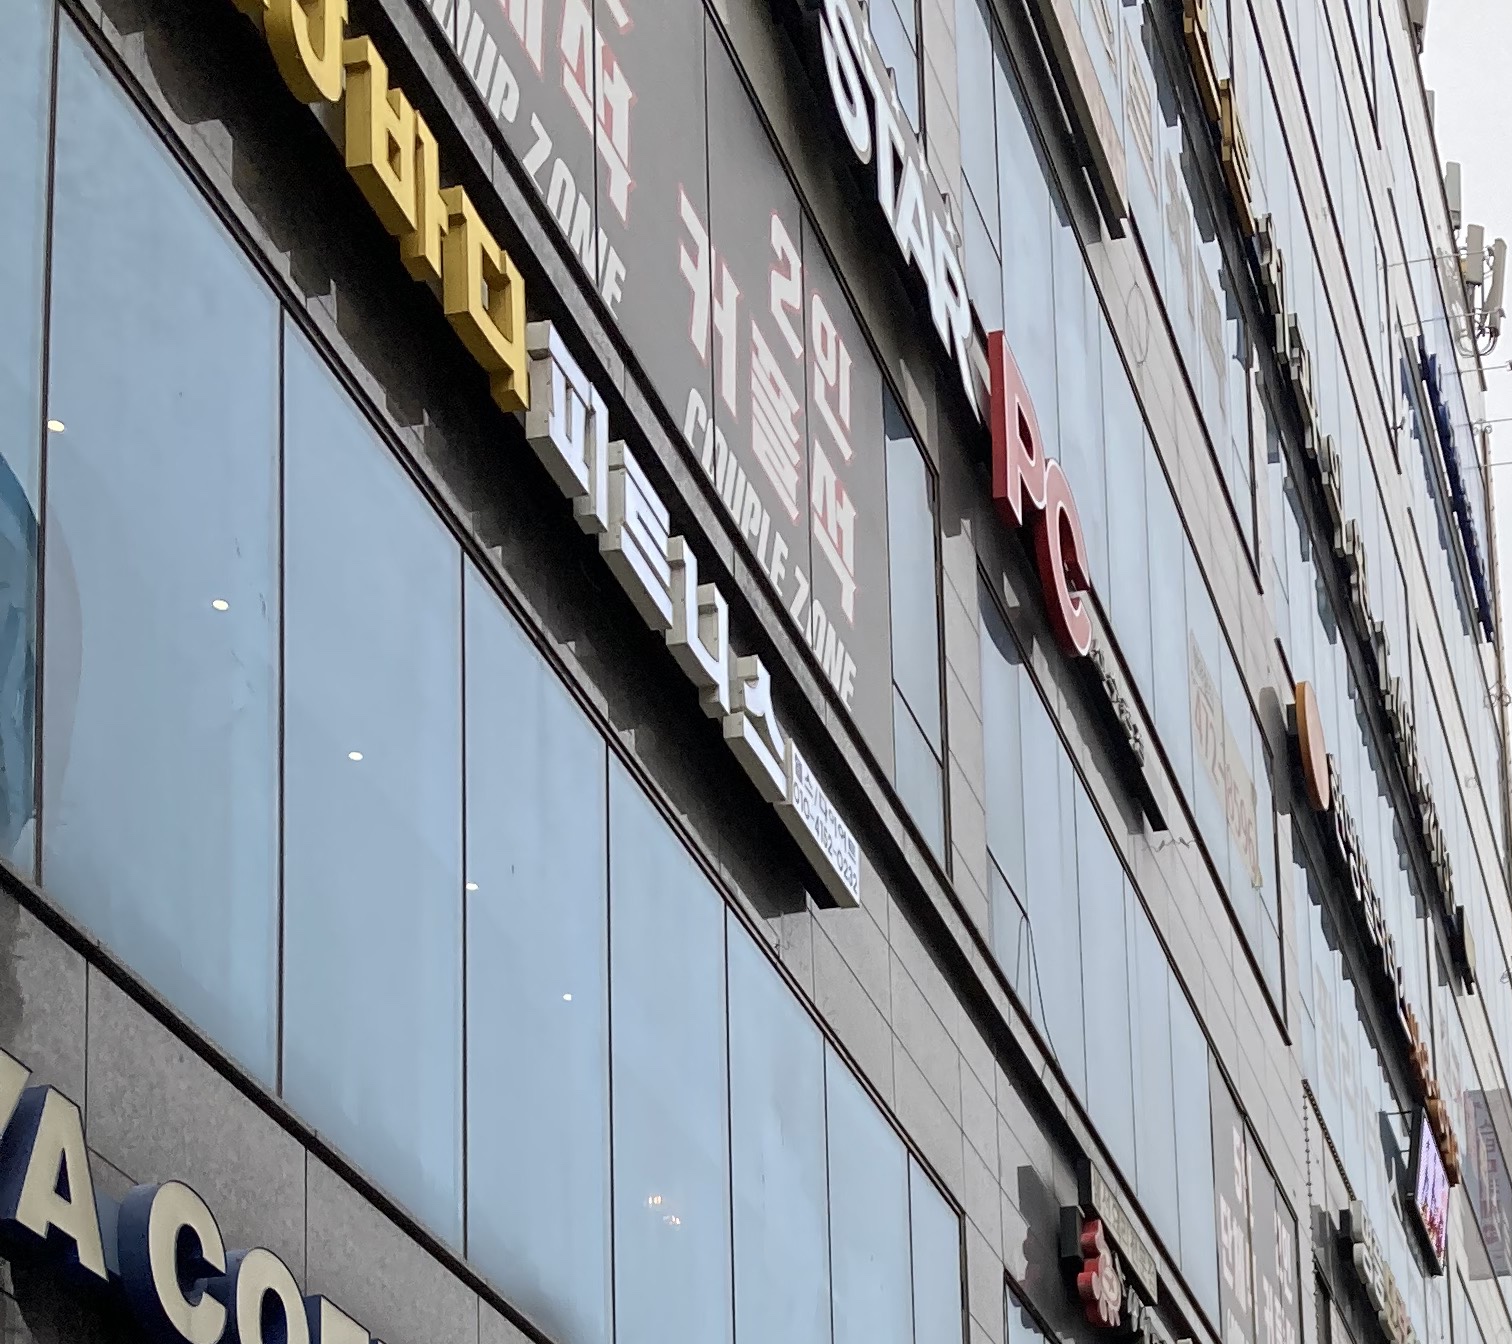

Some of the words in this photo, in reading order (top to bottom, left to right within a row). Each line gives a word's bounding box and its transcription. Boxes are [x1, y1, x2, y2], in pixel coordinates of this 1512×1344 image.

[521, 112, 627, 320] ZONE
[679, 187, 857, 624] 커플석
[771, 213, 853, 463] 2인
[820, 0, 982, 424] STAR
[989, 330, 1092, 657] PC
[525, 320, 788, 804] 피트니스
[685, 387, 790, 600] COUPLE
[790, 563, 857, 712] ZONE
